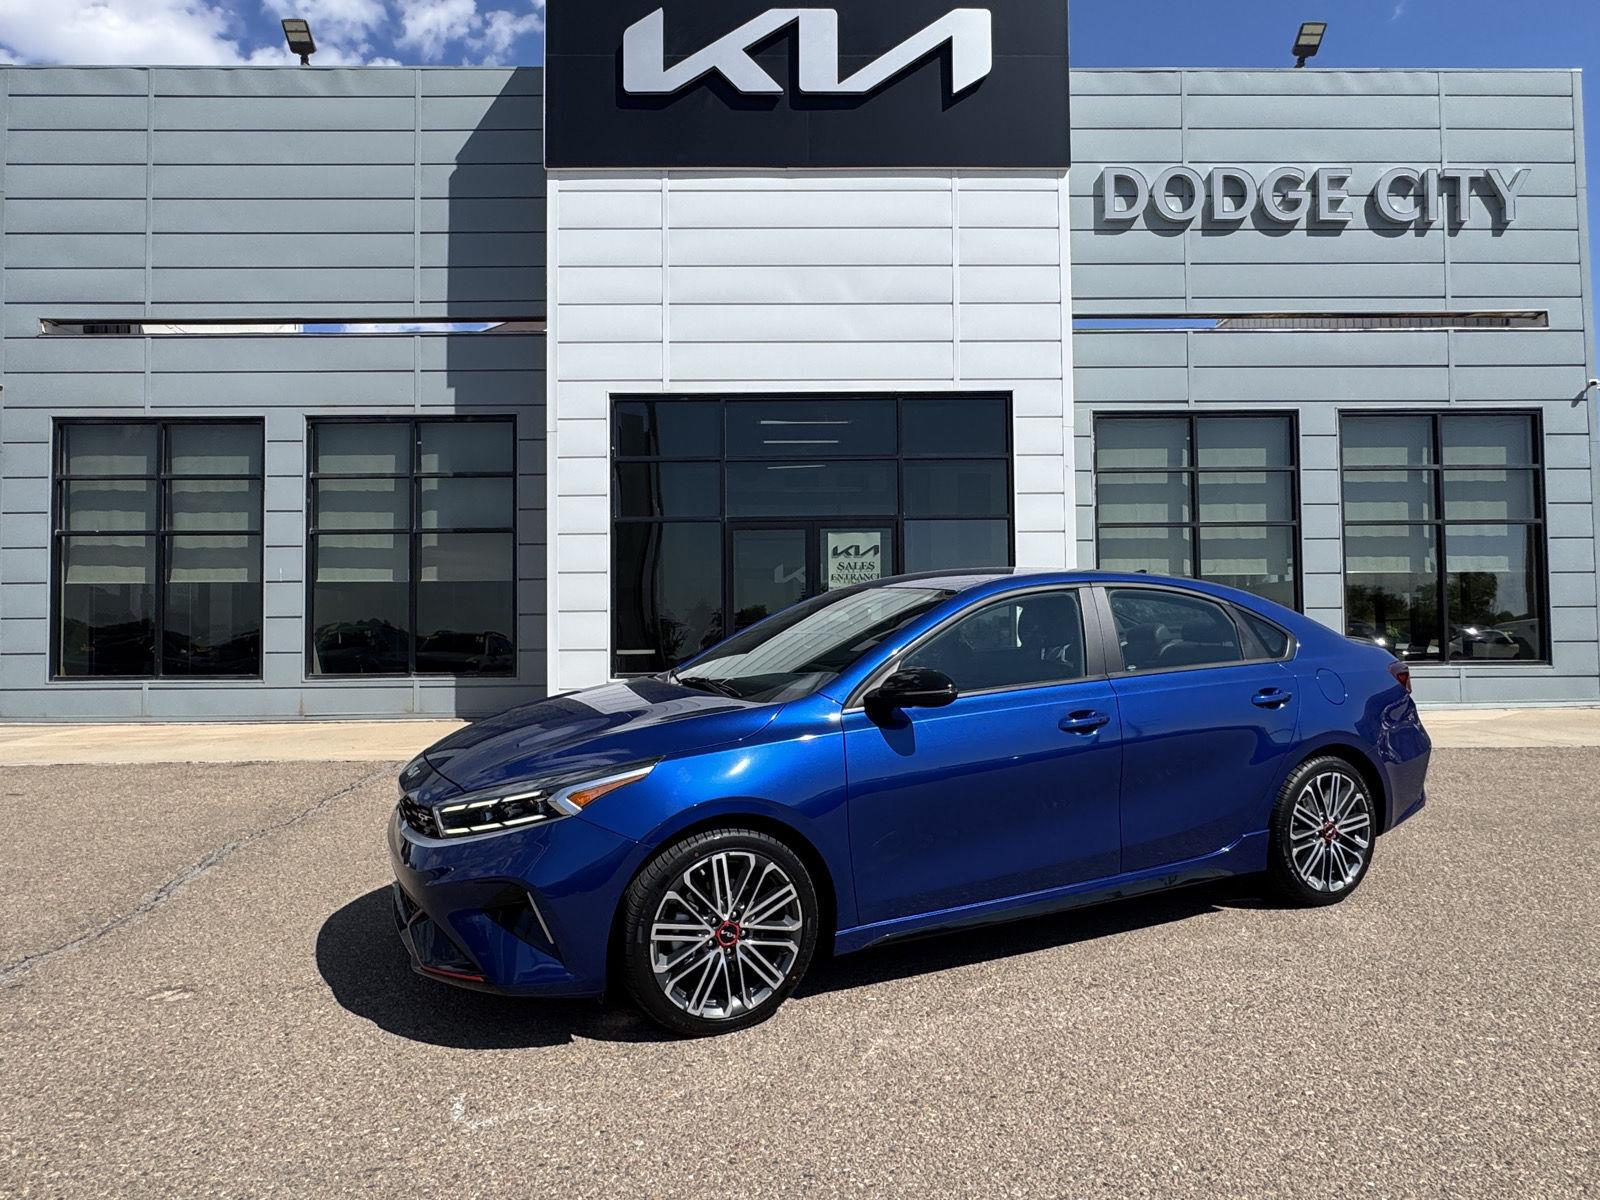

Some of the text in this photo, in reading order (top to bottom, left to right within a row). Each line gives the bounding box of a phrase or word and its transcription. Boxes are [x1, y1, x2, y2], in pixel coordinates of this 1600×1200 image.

[623, 7, 992, 95] KIA
[1102, 165, 1532, 223] DODGE CITY
[832, 544, 880, 557] KIA
[836, 561, 876, 570] SALES
